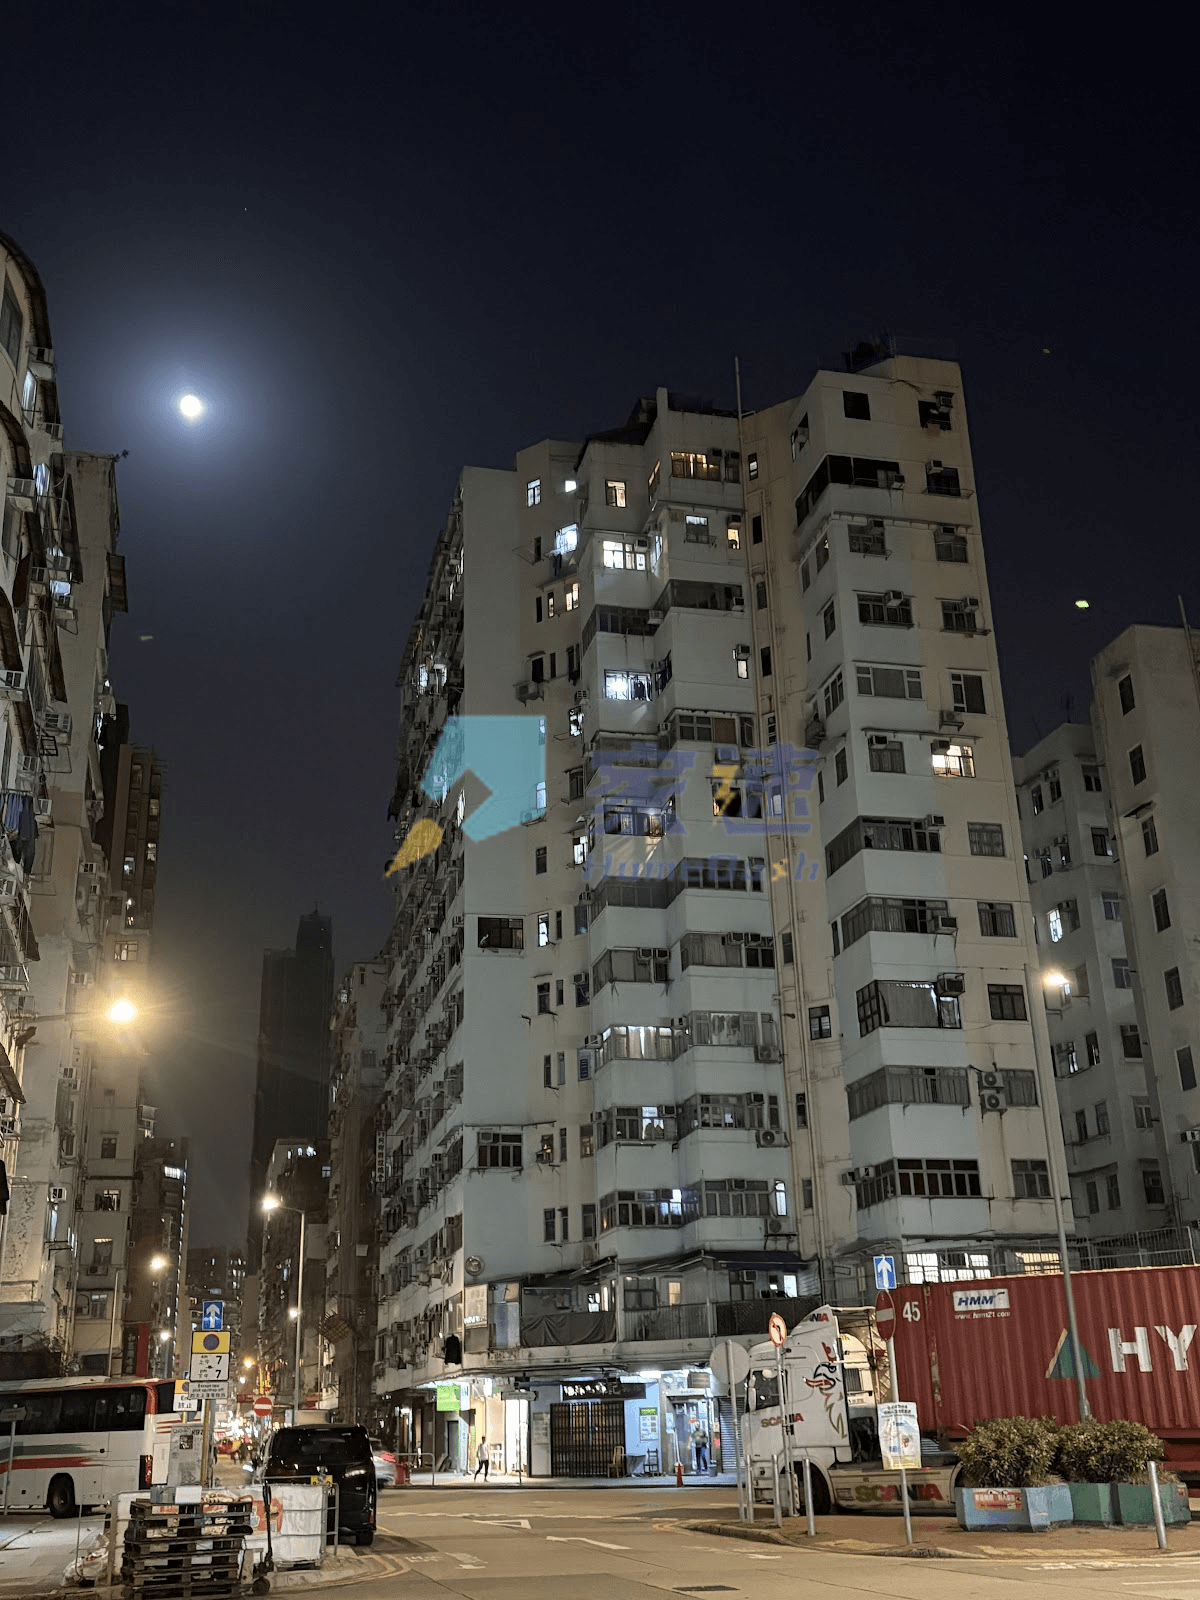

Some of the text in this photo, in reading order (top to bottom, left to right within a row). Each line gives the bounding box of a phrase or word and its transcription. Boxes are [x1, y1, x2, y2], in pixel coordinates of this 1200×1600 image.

[957, 1295, 996, 1306] HMM
[902, 1301, 921, 1322] 45
[1107, 1324, 1198, 1373] HY
[215, 1355, 222, 1365] 7
[215, 1369, 222, 1379] 7
